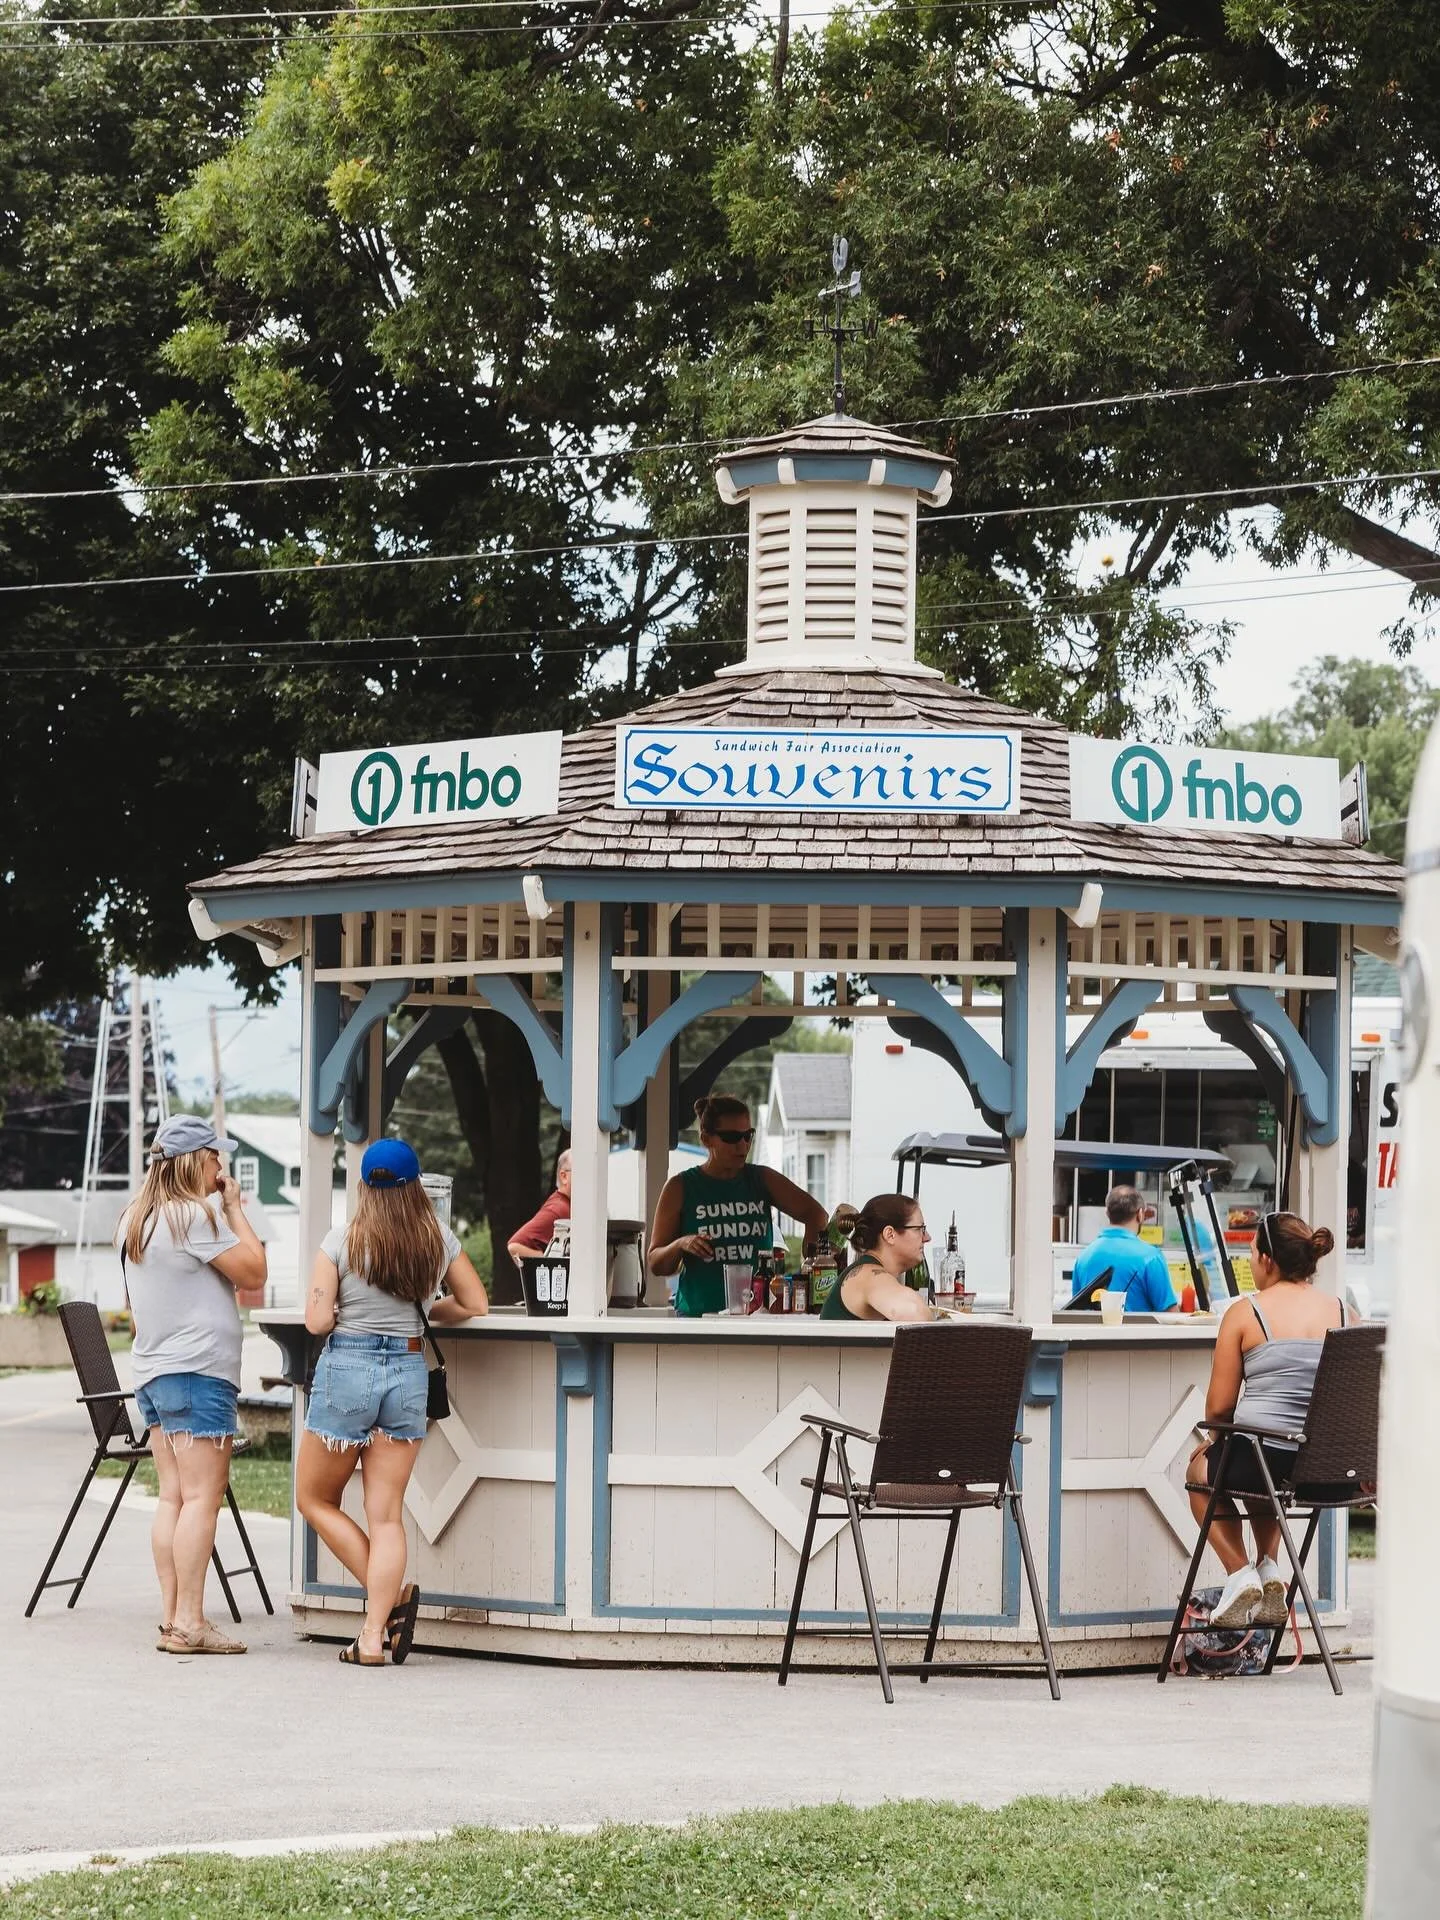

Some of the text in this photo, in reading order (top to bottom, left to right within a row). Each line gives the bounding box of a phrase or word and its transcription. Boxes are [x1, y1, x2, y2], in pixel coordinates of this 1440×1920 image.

[714, 739, 901, 754] Sandwich Fair Association
[628, 743, 992, 801] Souvenirs
[410, 751, 522, 815] fnbo
[1182, 759, 1303, 826] fnbo
[1379, 1082, 1400, 1128] S
[695, 1200, 764, 1219] SUNDAY
[697, 1221, 768, 1239] FUNDAY
[704, 1244, 754, 1262] REW
[547, 1302, 562, 1311] Keep
